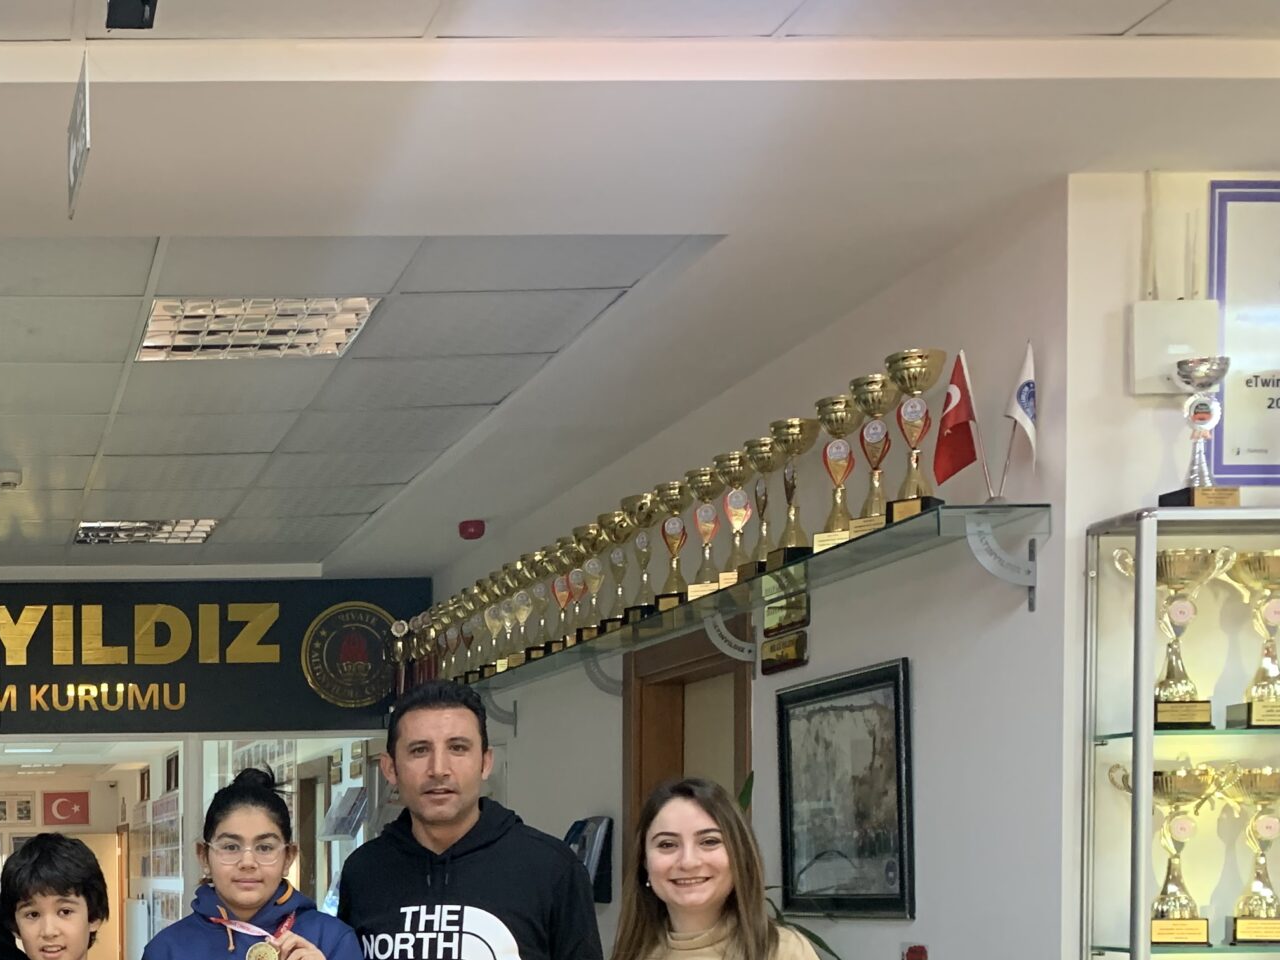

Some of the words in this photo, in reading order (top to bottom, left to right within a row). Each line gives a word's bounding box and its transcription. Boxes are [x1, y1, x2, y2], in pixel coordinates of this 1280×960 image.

[30, 682, 186, 712] KURUMU
[400, 904, 461, 932] THE
[362, 932, 459, 960] NORTH
